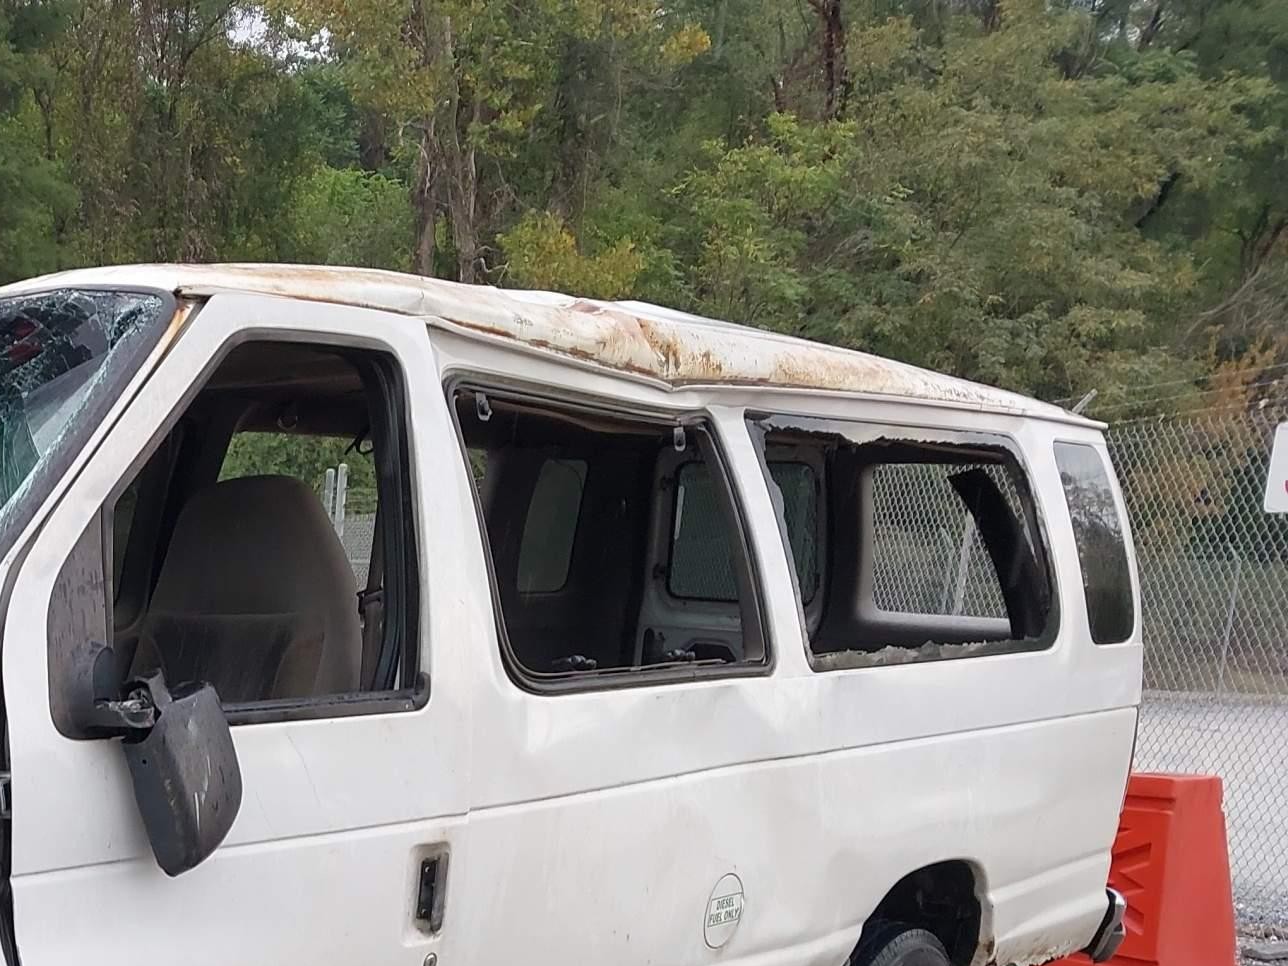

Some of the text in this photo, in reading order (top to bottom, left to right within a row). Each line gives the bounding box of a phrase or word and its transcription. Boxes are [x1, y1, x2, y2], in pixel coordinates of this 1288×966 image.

[717, 898, 734, 910] DIESEL
[710, 908, 739, 924] FUEL ONLY
